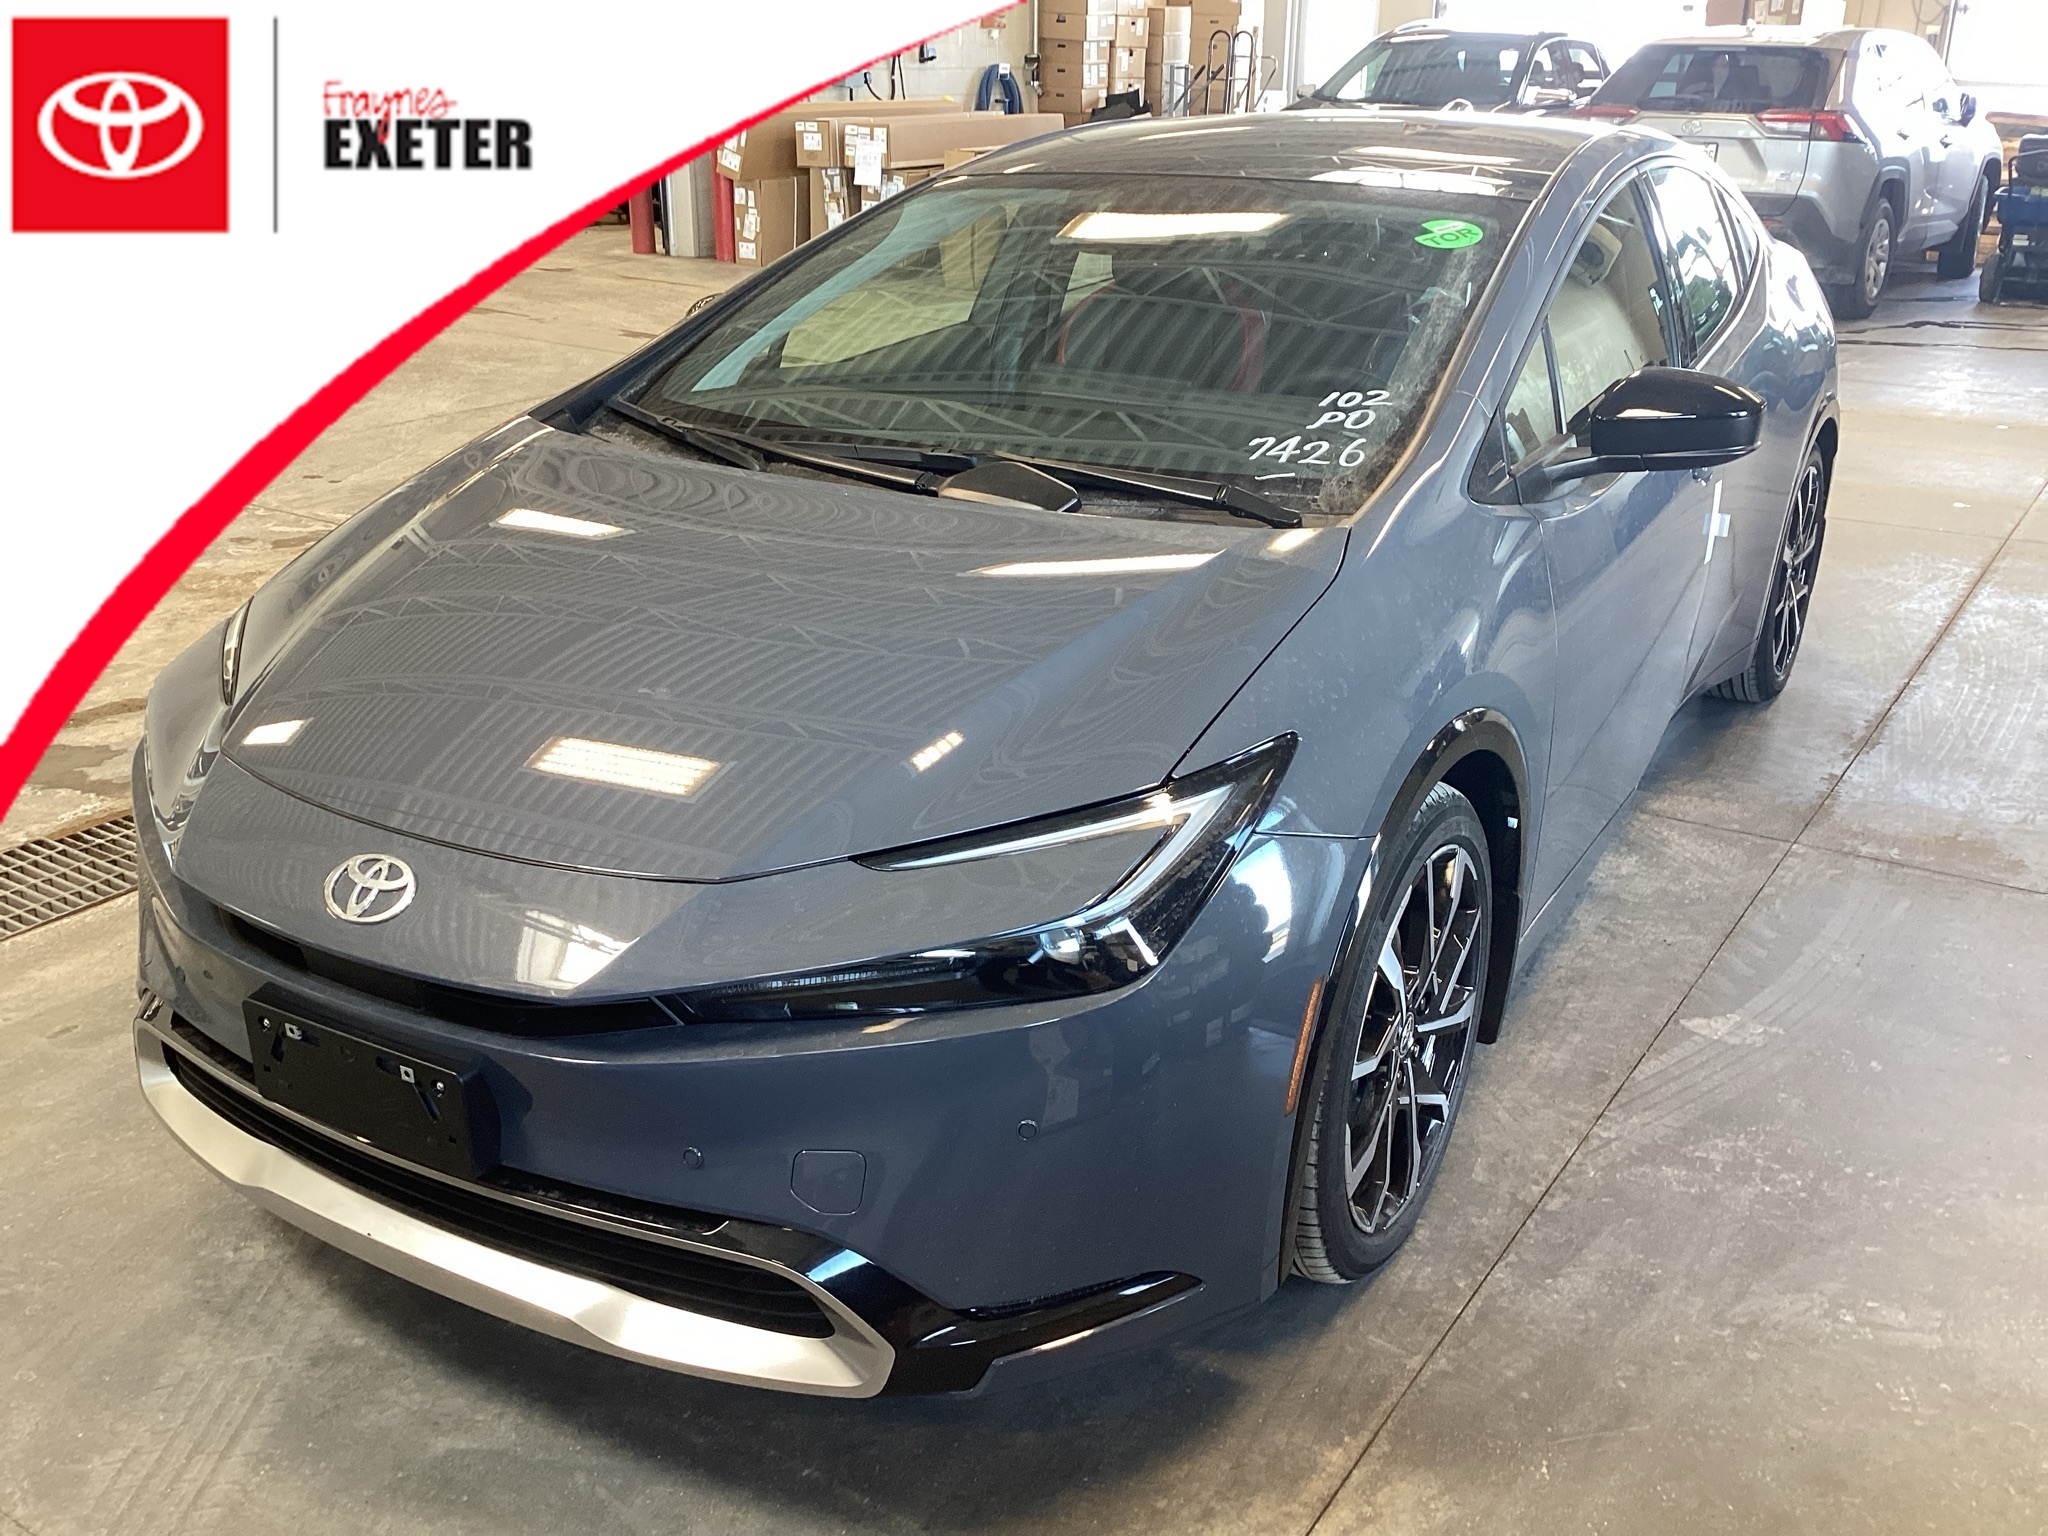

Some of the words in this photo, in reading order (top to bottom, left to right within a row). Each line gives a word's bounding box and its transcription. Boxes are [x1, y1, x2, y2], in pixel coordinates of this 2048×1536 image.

[1422, 228, 1479, 246] TOR
[1318, 389, 1393, 408] 102
[1248, 435, 1367, 467] 7426
